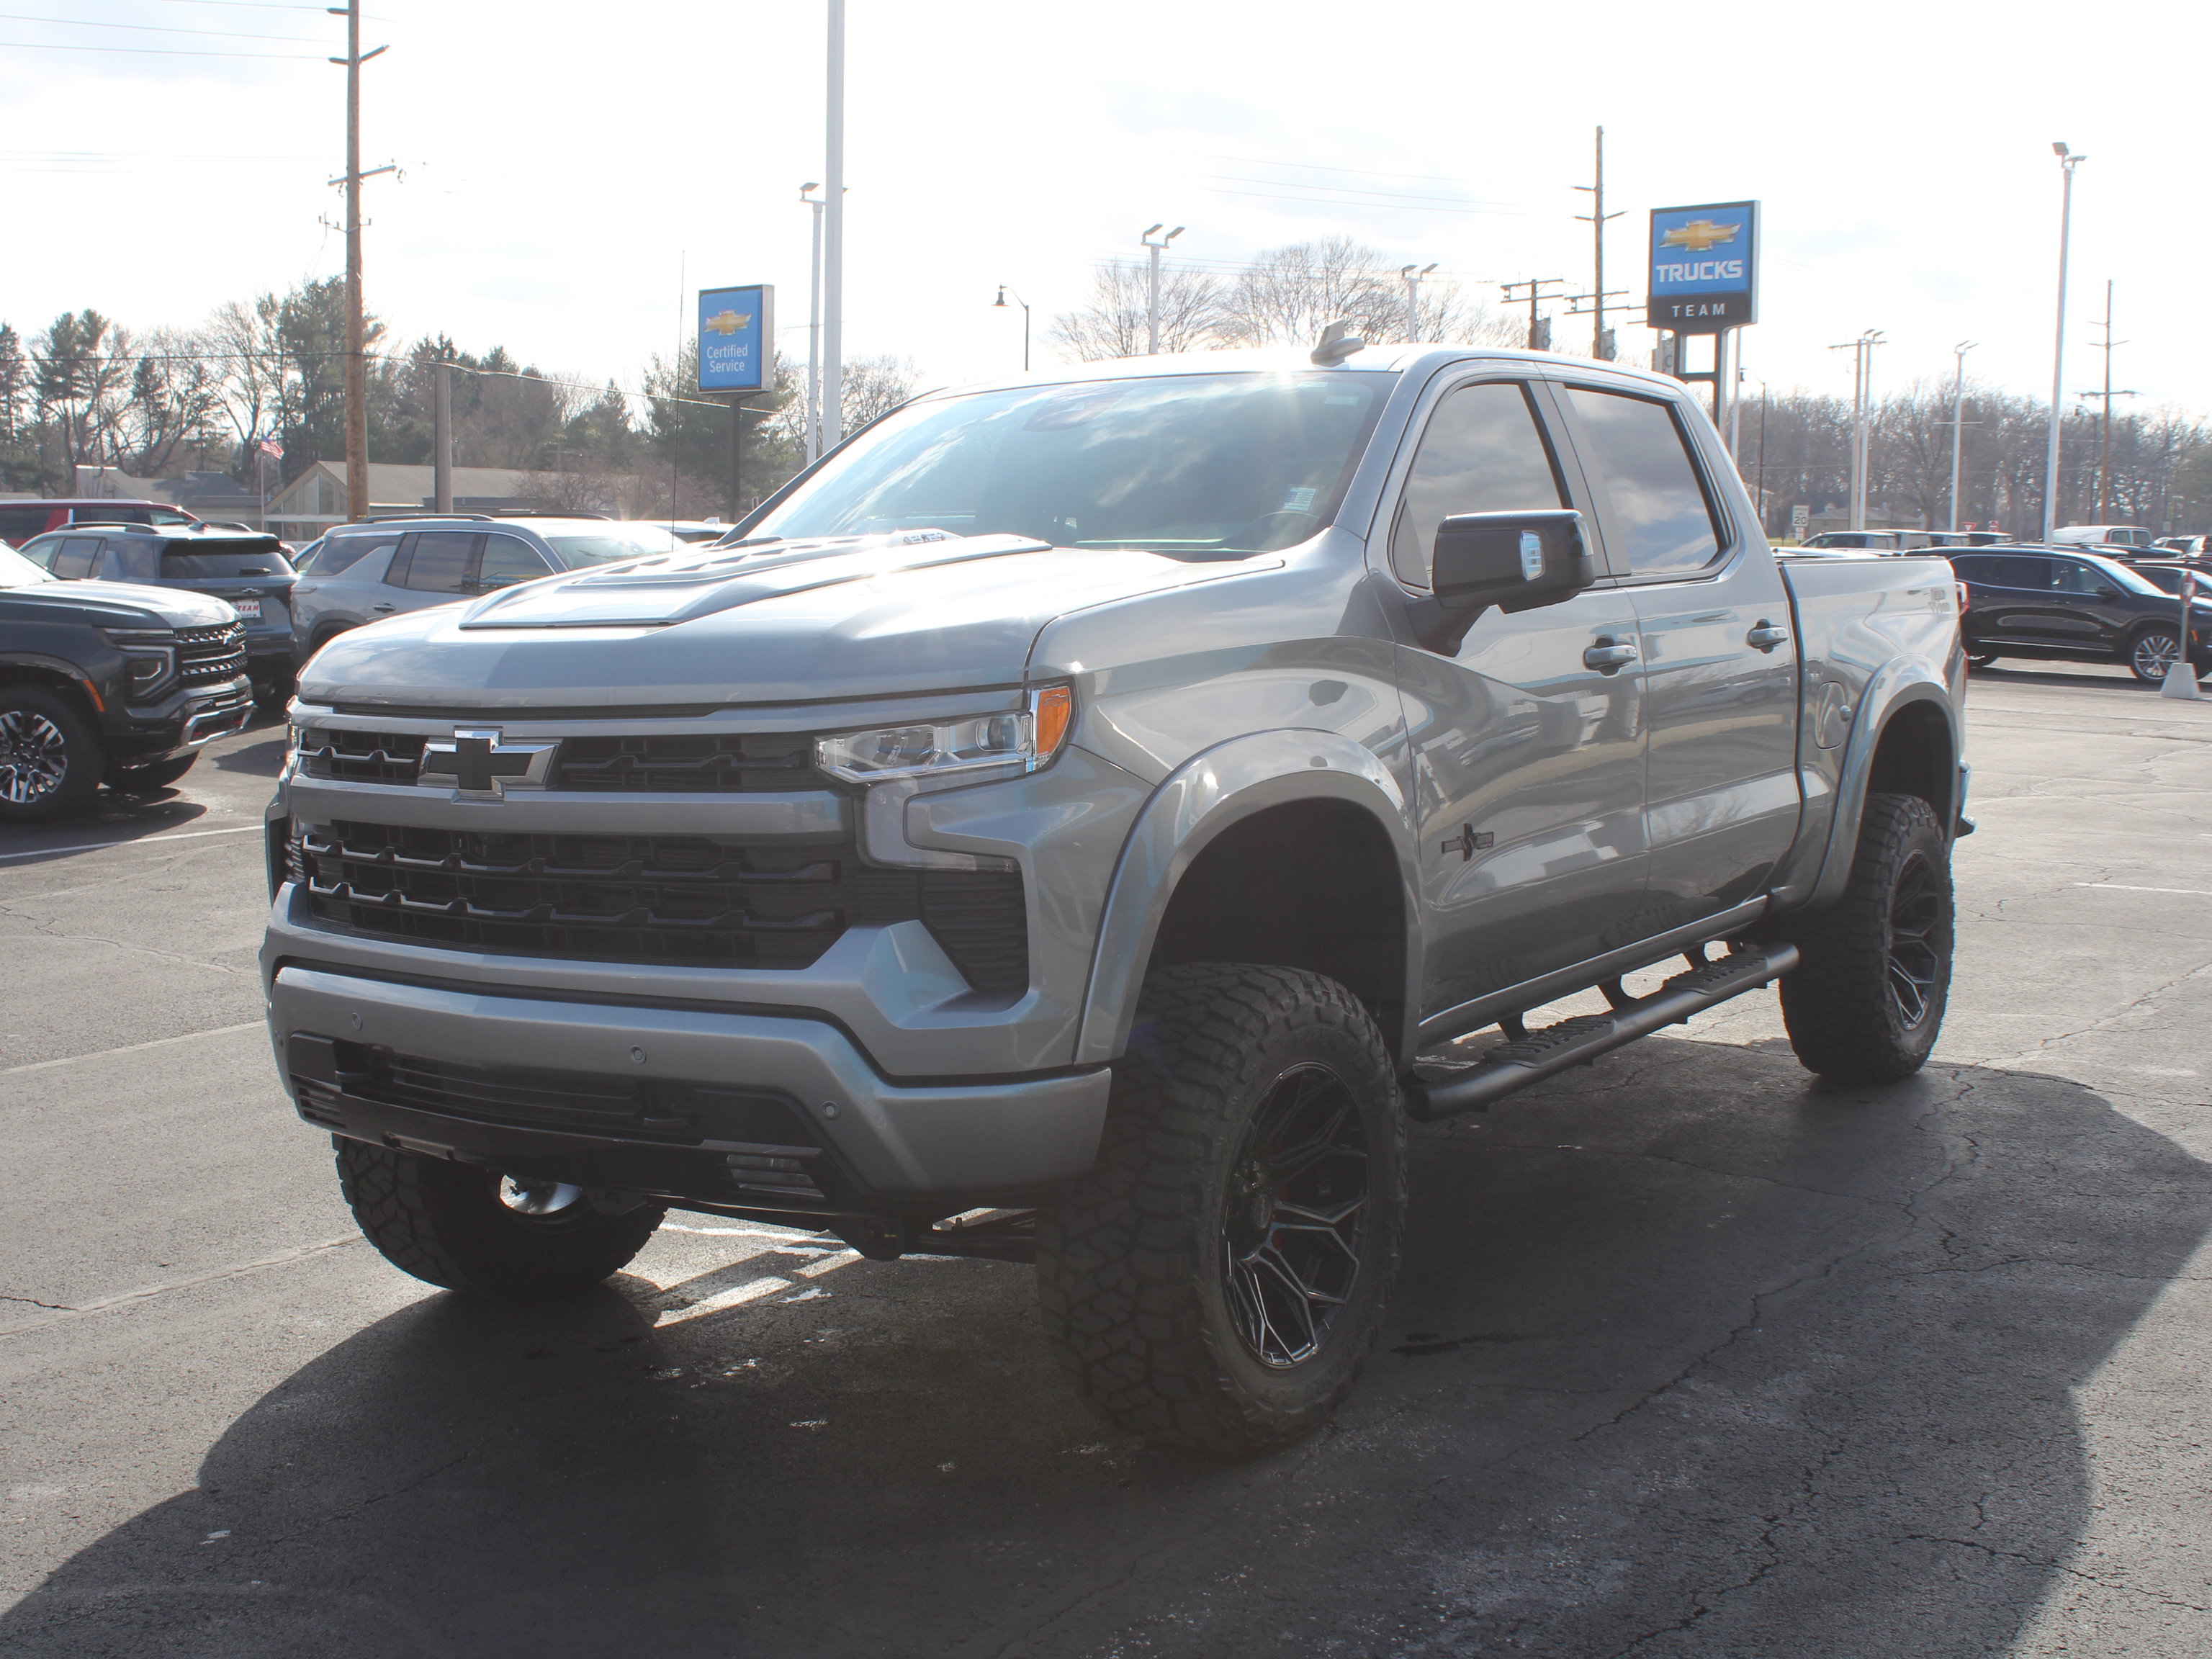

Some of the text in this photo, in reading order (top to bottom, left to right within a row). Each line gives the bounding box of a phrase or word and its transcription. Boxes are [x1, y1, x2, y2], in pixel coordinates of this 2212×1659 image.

[1655, 260, 1743, 282] TRUCKS
[1671, 303, 1725, 318] TEAM
[706, 343, 748, 359] Certified
[710, 359, 745, 373] Service
[1794, 516, 1807, 525] 20
